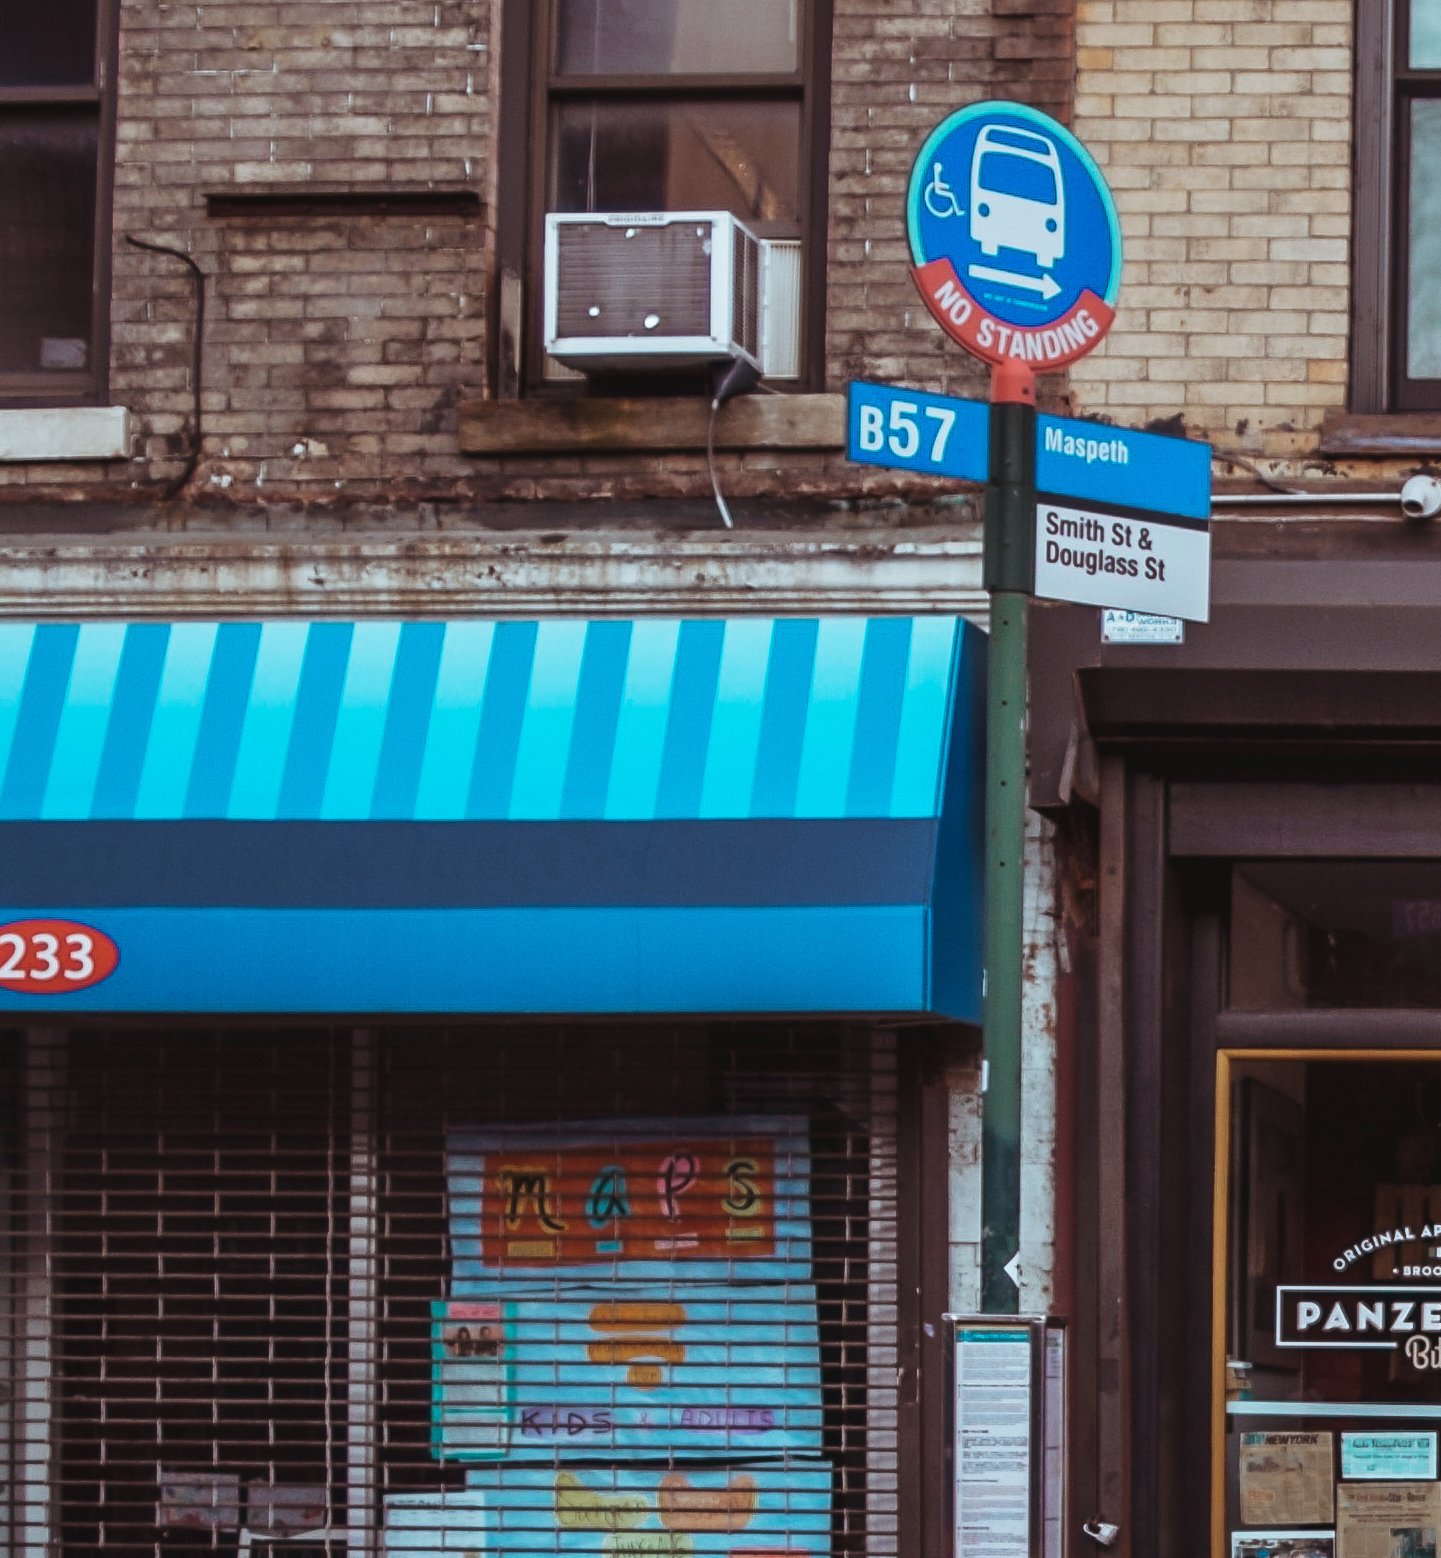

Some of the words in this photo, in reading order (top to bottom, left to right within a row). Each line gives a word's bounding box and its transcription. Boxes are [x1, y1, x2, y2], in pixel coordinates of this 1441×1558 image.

[934, 280, 972, 325] NO
[976, 309, 1099, 361] STANDING
[860, 400, 956, 463] B57
[1045, 427, 1128, 464] Maspeth
[1046, 511, 1105, 543] Smith
[1112, 523, 1132, 548] St
[1138, 527, 1153, 551] &
[1046, 541, 1138, 576] Douglass
[1145, 557, 1165, 581] St
[0, 933, 94, 980] 233
[1333, 1227, 1416, 1272] ORIGINAL
[519, 1410, 612, 1435] KIDS
